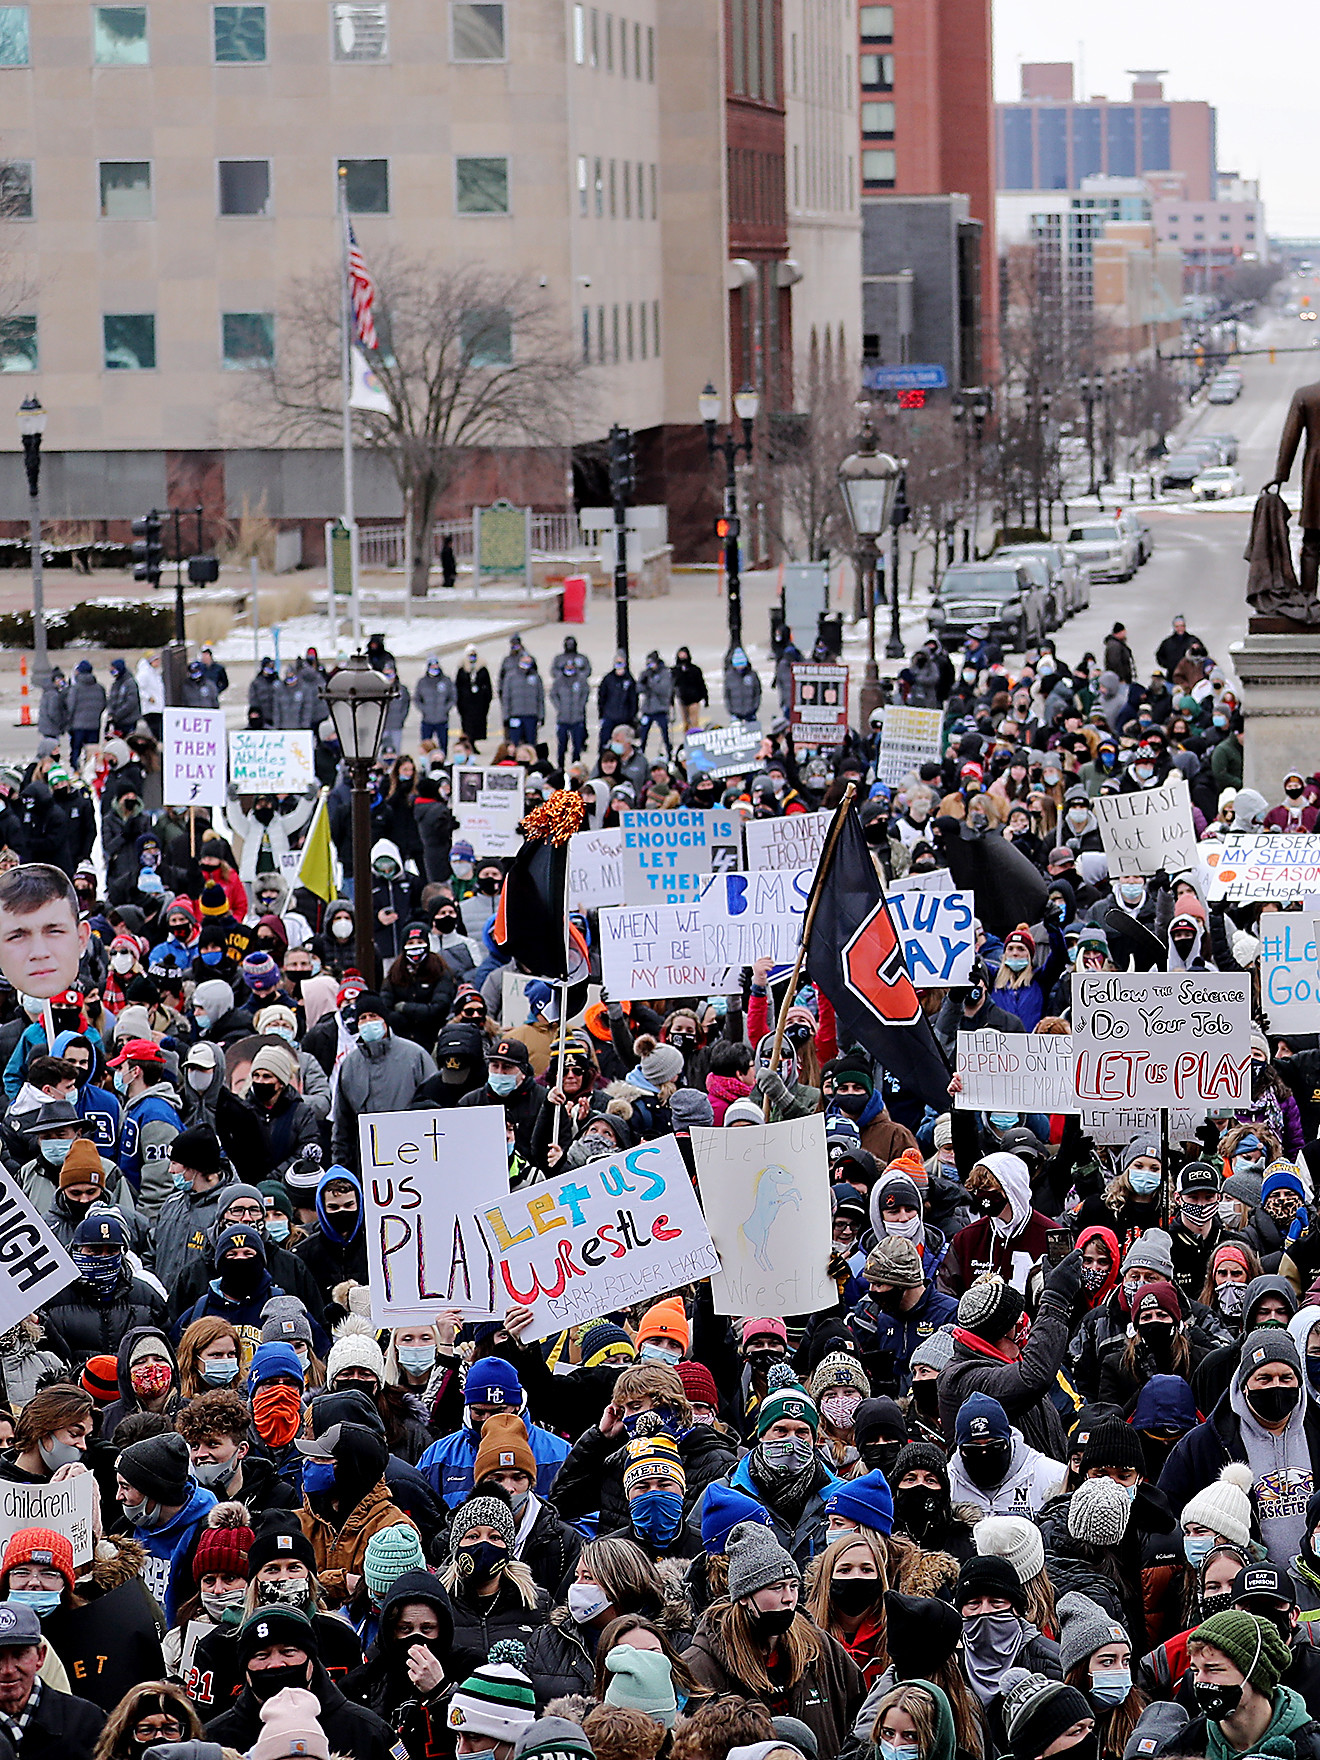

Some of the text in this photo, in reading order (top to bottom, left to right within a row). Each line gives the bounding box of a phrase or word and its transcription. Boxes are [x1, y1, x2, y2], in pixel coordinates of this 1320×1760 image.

[175, 741, 217, 757] THEM
[233, 734, 286, 751] Student
[234, 751, 287, 767] Athletes
[175, 765, 216, 780] PLAY
[233, 766, 285, 780] Matter
[1099, 786, 1179, 824] PLEASE
[623, 811, 732, 838] ENOUGH IS
[771, 815, 826, 843] HOMER
[625, 831, 706, 849] ENOUGH
[1111, 825, 1189, 852] let us
[1228, 836, 1241, 848] I
[639, 851, 678, 869] LET
[761, 836, 825, 866] TROJA
[1119, 848, 1191, 873] PLAY
[1222, 849, 1253, 863] MY
[647, 873, 700, 891] THE
[606, 910, 659, 941] WHEN
[632, 940, 692, 963] IT BE
[1261, 926, 1318, 963] #Le
[630, 965, 659, 989] MY
[664, 965, 706, 986] TURN
[1080, 977, 1246, 1008] Follow THE Science
[1091, 1009, 1131, 1041] Do
[1137, 1006, 1187, 1037] Your
[1190, 1010, 1234, 1038] Job
[497, 1042, 509, 1054] C
[962, 1033, 1072, 1055] THEIR LIVES
[957, 1052, 1071, 1073] DEPEND ON IT
[1075, 1049, 1151, 1101] LET
[1173, 1049, 1251, 1100] PLAY
[1082, 1109, 1110, 1128] LET
[1115, 1110, 1157, 1128] THEM
[369, 1117, 446, 1167] Let
[693, 1128, 776, 1163] #Let
[230, 1234, 247, 1248] W
[547, 1285, 598, 1320] BARK
[603, 1263, 661, 1299] RIVER
[720, 1264, 826, 1309] Wrestle
[574, 1295, 610, 1323] North
[3, 1483, 79, 1520] children!!
[1013, 1487, 1029, 1502] N
[256, 1622, 269, 1639] S
